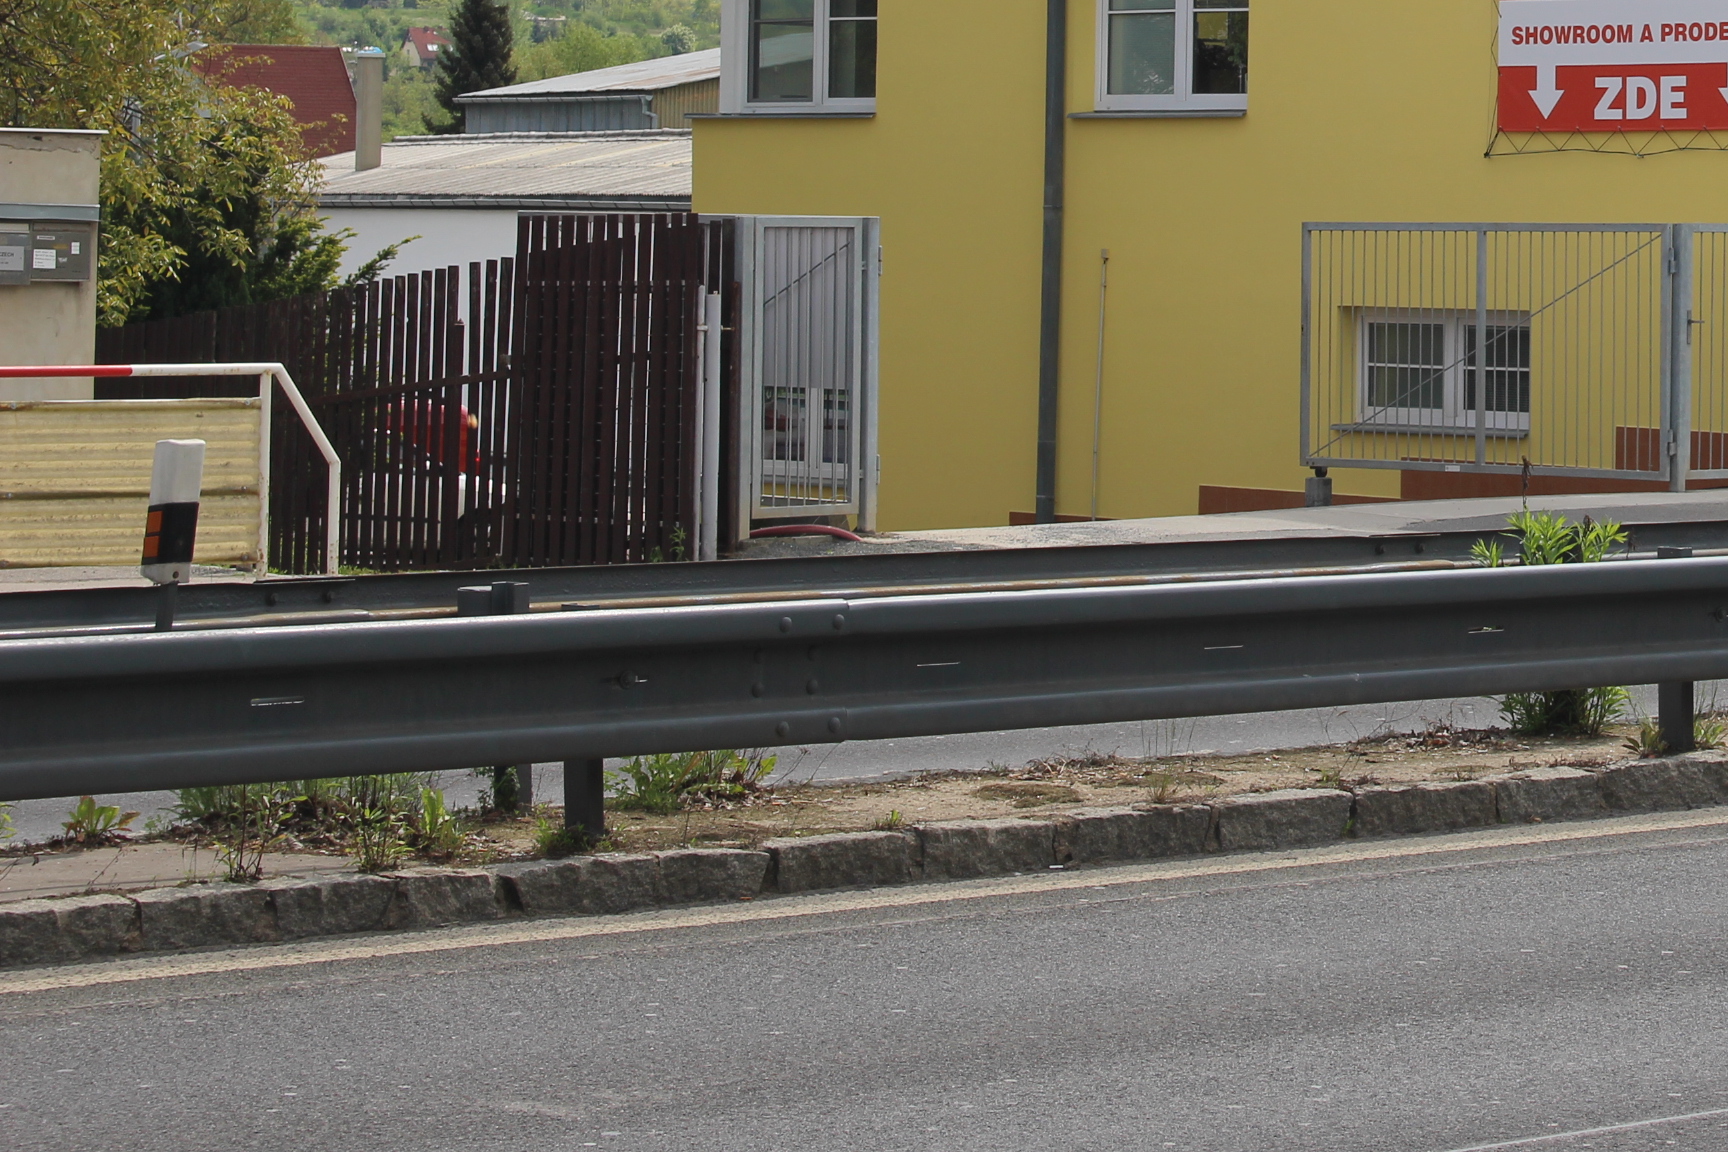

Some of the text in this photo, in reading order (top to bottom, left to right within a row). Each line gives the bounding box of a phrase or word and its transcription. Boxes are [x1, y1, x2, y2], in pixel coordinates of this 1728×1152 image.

[1511, 24, 1633, 46] SHOWROOM
[1640, 24, 1654, 43] A
[1593, 75, 1688, 121] ZDE
